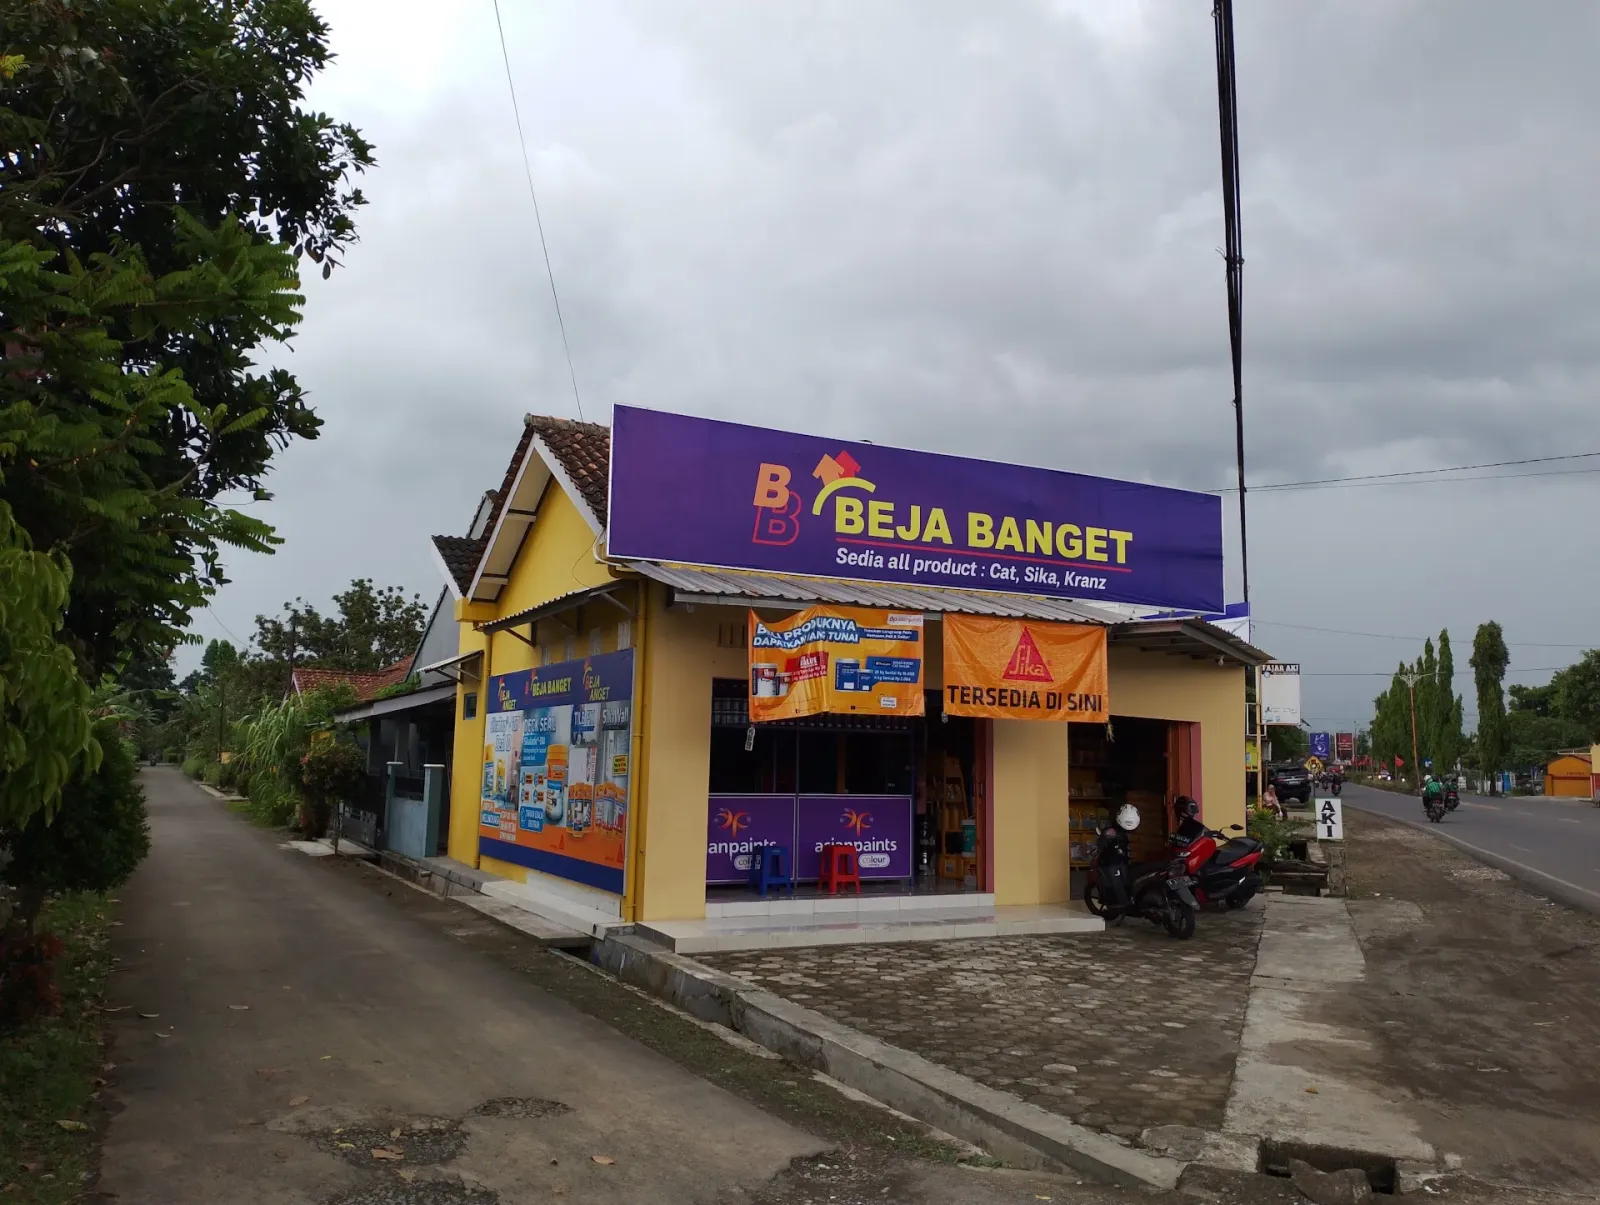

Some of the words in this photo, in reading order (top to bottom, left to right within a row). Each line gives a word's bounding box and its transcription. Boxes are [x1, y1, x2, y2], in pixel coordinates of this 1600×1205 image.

[753, 463, 792, 508] B
[834, 496, 953, 544] BEJA
[967, 512, 1133, 564] BANGET
[836, 547, 884, 569] Sedia
[887, 552, 910, 570] all
[913, 554, 977, 579] product
[989, 562, 1020, 583] Cat,
[1023, 565, 1060, 588] Sika,
[1064, 570, 1107, 590] Kranz
[828, 631, 859, 643] TUNAI
[1008, 644, 1045, 677] Sika
[547, 677, 572, 695] BANGET
[947, 685, 1041, 709] TERSEDIA
[1046, 691, 1062, 710] DI
[1067, 693, 1102, 712] SINI
[1320, 800, 1337, 837] AKI
